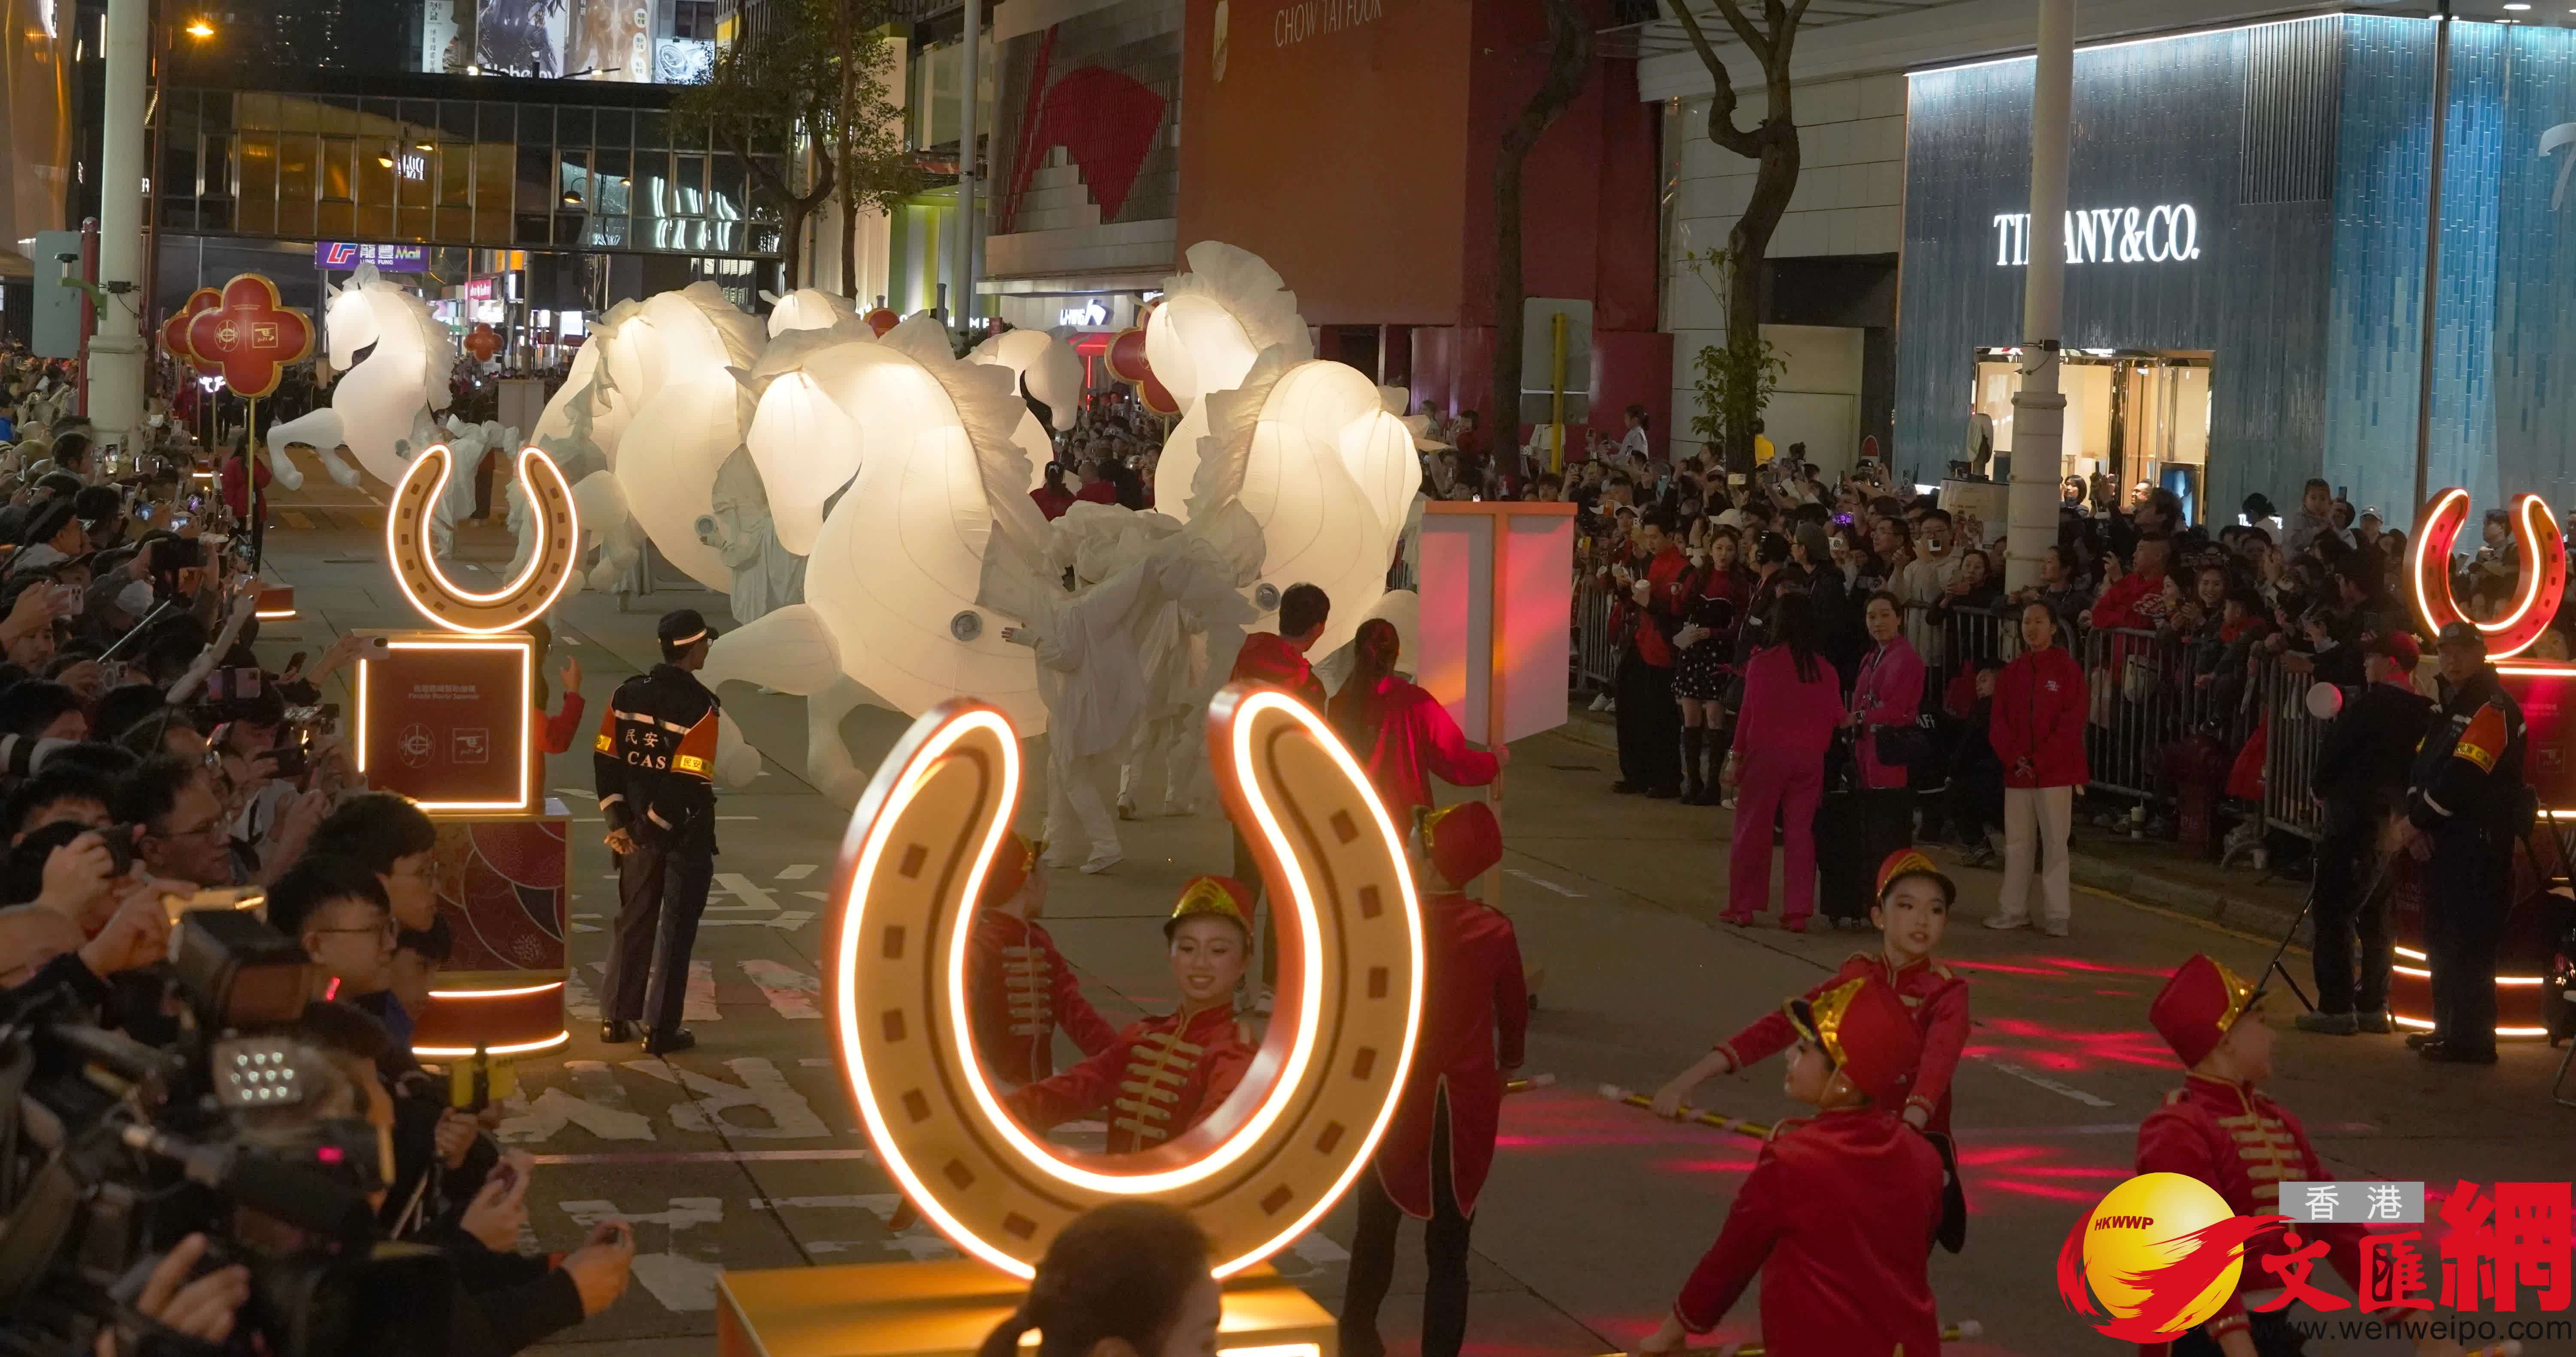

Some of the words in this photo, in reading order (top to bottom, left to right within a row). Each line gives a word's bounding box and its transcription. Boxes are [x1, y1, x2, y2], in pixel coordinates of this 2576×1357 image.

[1275, 1, 1318, 47] CHOW
[1993, 204, 2200, 266] TIANY&CO.
[395, 245, 421, 260] Mall
[627, 751, 666, 770] CAS
